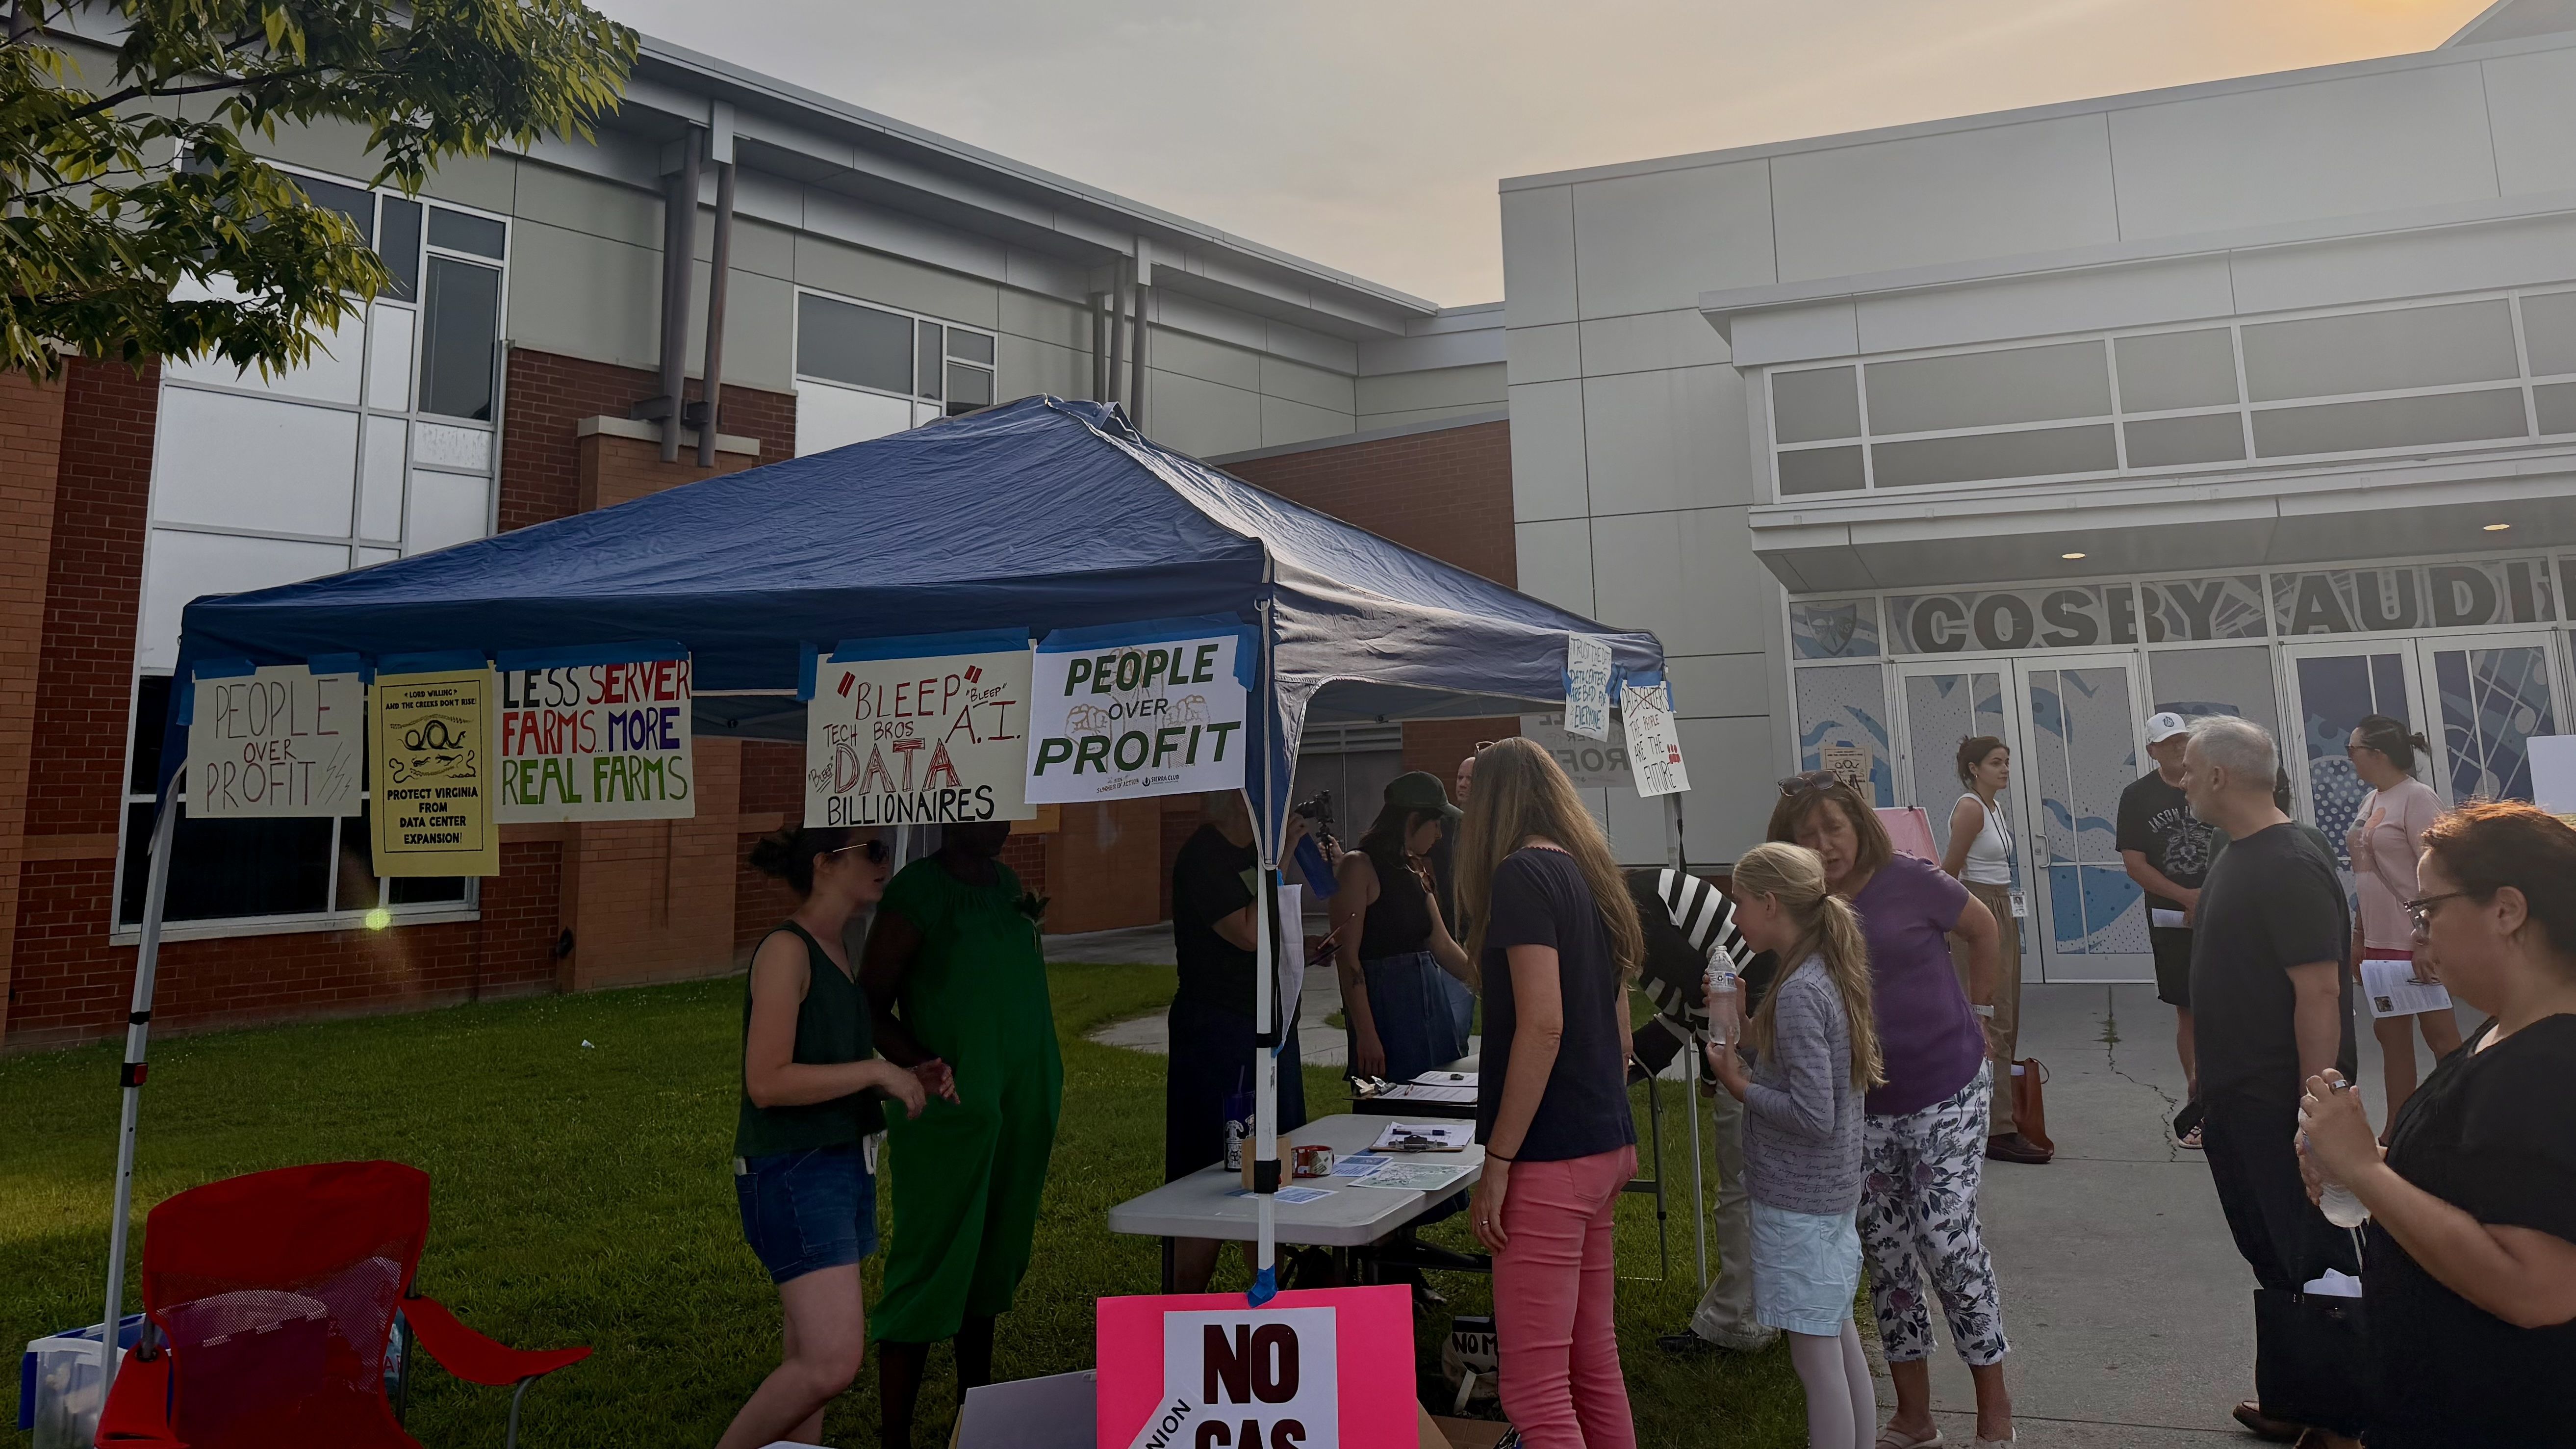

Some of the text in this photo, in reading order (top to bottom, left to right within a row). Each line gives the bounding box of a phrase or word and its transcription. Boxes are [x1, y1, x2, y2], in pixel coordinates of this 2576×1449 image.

[1911, 581, 2224, 653] COSBY
[503, 660, 691, 709] LESS SERVER
[1064, 644, 1219, 696] PEOPLE
[216, 678, 339, 739] PEOPLE
[1108, 698, 1168, 720] OVER
[1571, 686, 1581, 702] ARE
[1582, 684, 1596, 702] BAD
[609, 707, 680, 752] MORE
[823, 721, 914, 748] TECH BROS
[945, 700, 1021, 744] A.I.
[1629, 714, 1660, 741] THE PEOPLE
[244, 738, 297, 763] OVER
[1033, 721, 1242, 776] PROFIT
[1634, 734, 1664, 764] ARE THE
[503, 755, 688, 805] REAL FARMS
[835, 738, 963, 796] DATA
[1644, 761, 1677, 793] FUTURE
[206, 761, 316, 812] PROFIT
[387, 786, 478, 800] PROTECT VIRGINIA
[400, 816, 466, 828] DATA CENTER
[419, 802, 448, 813] FROM
[828, 785, 995, 826] BILLIONAIRES
[2148, 808, 2180, 833] JASON
[404, 832, 462, 844] EXPANSION!
[1452, 1333, 1479, 1354] NO
[1203, 1323, 1299, 1404] NO
[1146, 1398, 1191, 1449] NION
